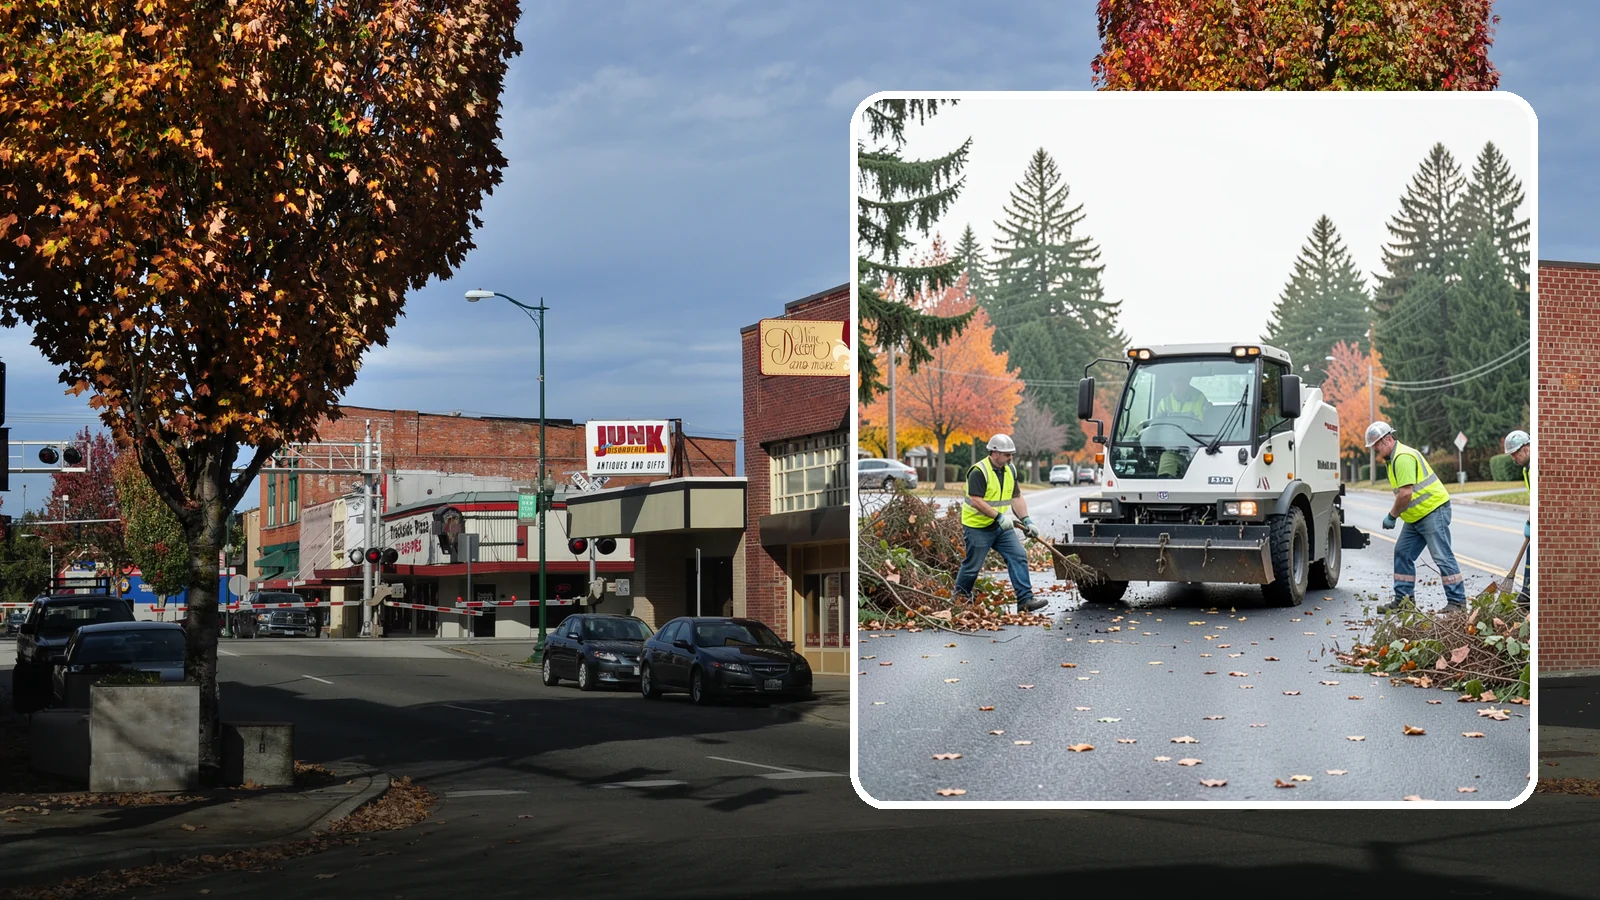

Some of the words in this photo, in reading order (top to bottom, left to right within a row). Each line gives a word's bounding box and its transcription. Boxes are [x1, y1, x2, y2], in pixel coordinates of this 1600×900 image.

[596, 425, 665, 457] JUNK
[607, 446, 646, 454] DISORDERLY
[596, 461, 628, 470] ANTIQUES
[631, 461, 644, 470] AND
[646, 460, 665, 470] GIFTS
[590, 476, 608, 491] SING
[390, 521, 413, 540] Trackside
[414, 519, 430, 535] Pizza
